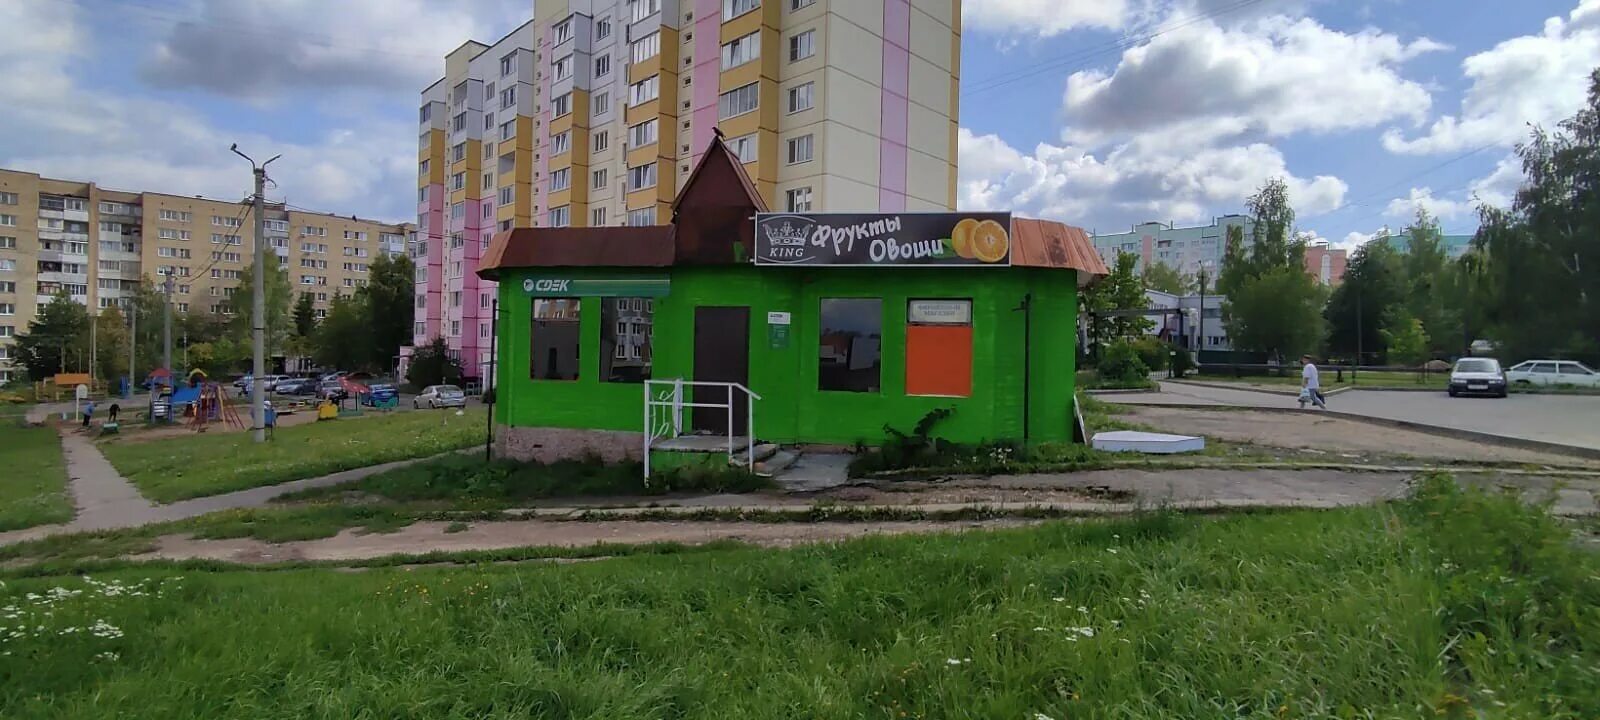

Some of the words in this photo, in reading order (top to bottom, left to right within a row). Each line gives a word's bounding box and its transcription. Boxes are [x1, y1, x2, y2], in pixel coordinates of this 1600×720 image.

[811, 215, 901, 256] Фрукты
[769, 247, 804, 257] KING
[868, 237, 945, 262] Овощи
